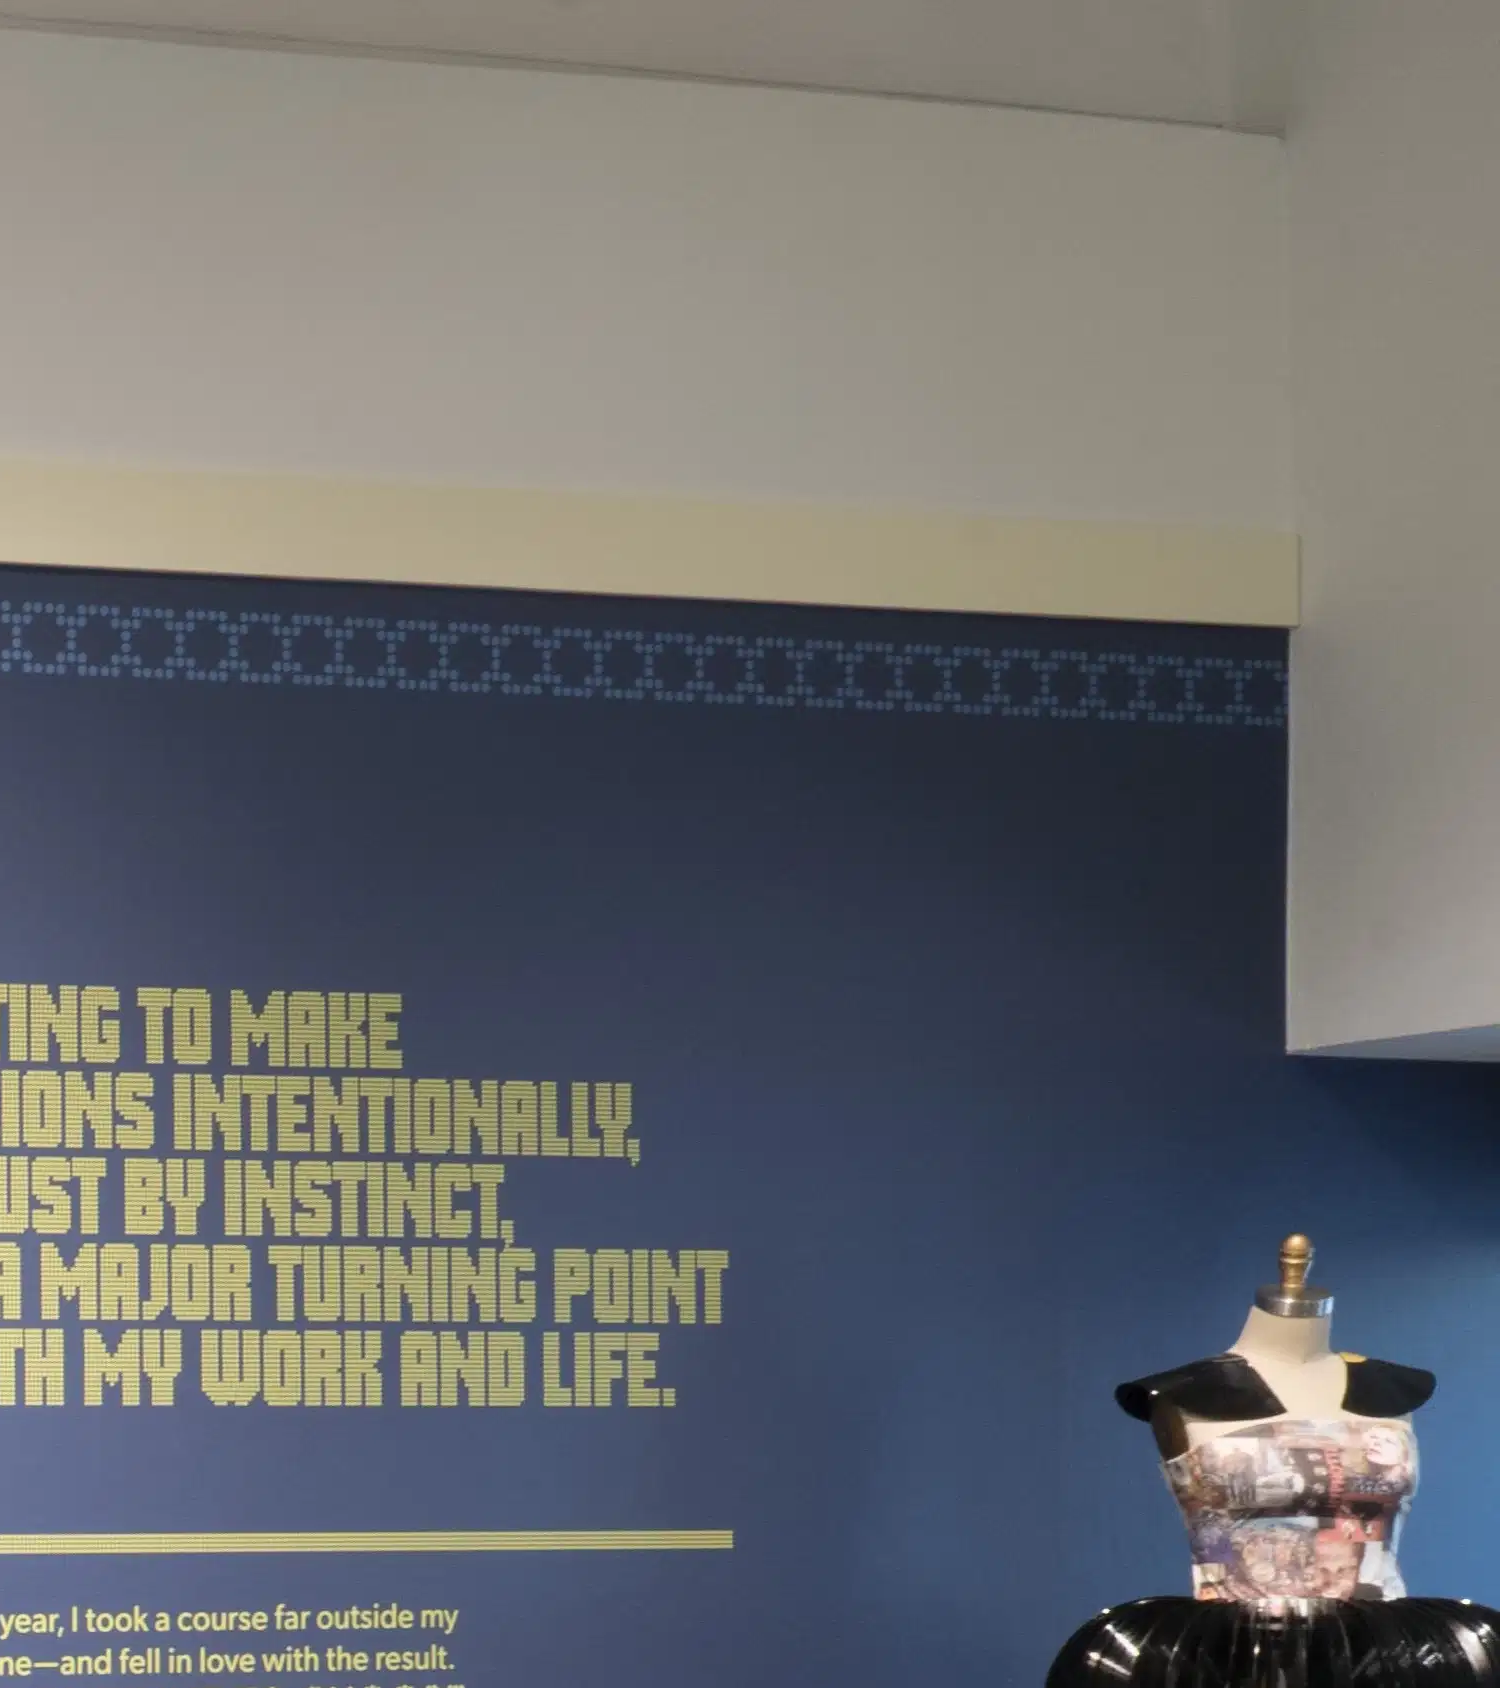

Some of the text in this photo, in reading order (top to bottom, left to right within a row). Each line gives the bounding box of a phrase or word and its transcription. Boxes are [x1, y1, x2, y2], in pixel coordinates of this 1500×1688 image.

[137, 987, 213, 1066] TO
[230, 989, 403, 1070] MAKE
[172, 1073, 640, 1159] INTENTIONALLY,
[123, 1156, 206, 1237] BY
[223, 1159, 514, 1244] INSTINCT,
[39, 1242, 253, 1323] MAJOR
[267, 1244, 537, 1324] TURNING
[554, 1248, 730, 1326] POINT
[82, 1327, 183, 1407] MY
[200, 1328, 383, 1409] WORK
[400, 1331, 526, 1409] AND
[543, 1332, 677, 1409] LIFE.
[0, 1613, 64, 1642] year,
[70, 1606, 80, 1634] I
[84, 1606, 150, 1634] took
[154, 1611, 172, 1634] a
[175, 1610, 271, 1633] course
[274, 1603, 311, 1633] far
[315, 1603, 415, 1631] outside
[419, 1608, 459, 1634] my
[118, 1647, 163, 1676] fell
[167, 1652, 194, 1675] in
[197, 1647, 257, 1675] love
[261, 1647, 321, 1674] with
[325, 1647, 370, 1674] the
[374, 1644, 454, 1672] result.
